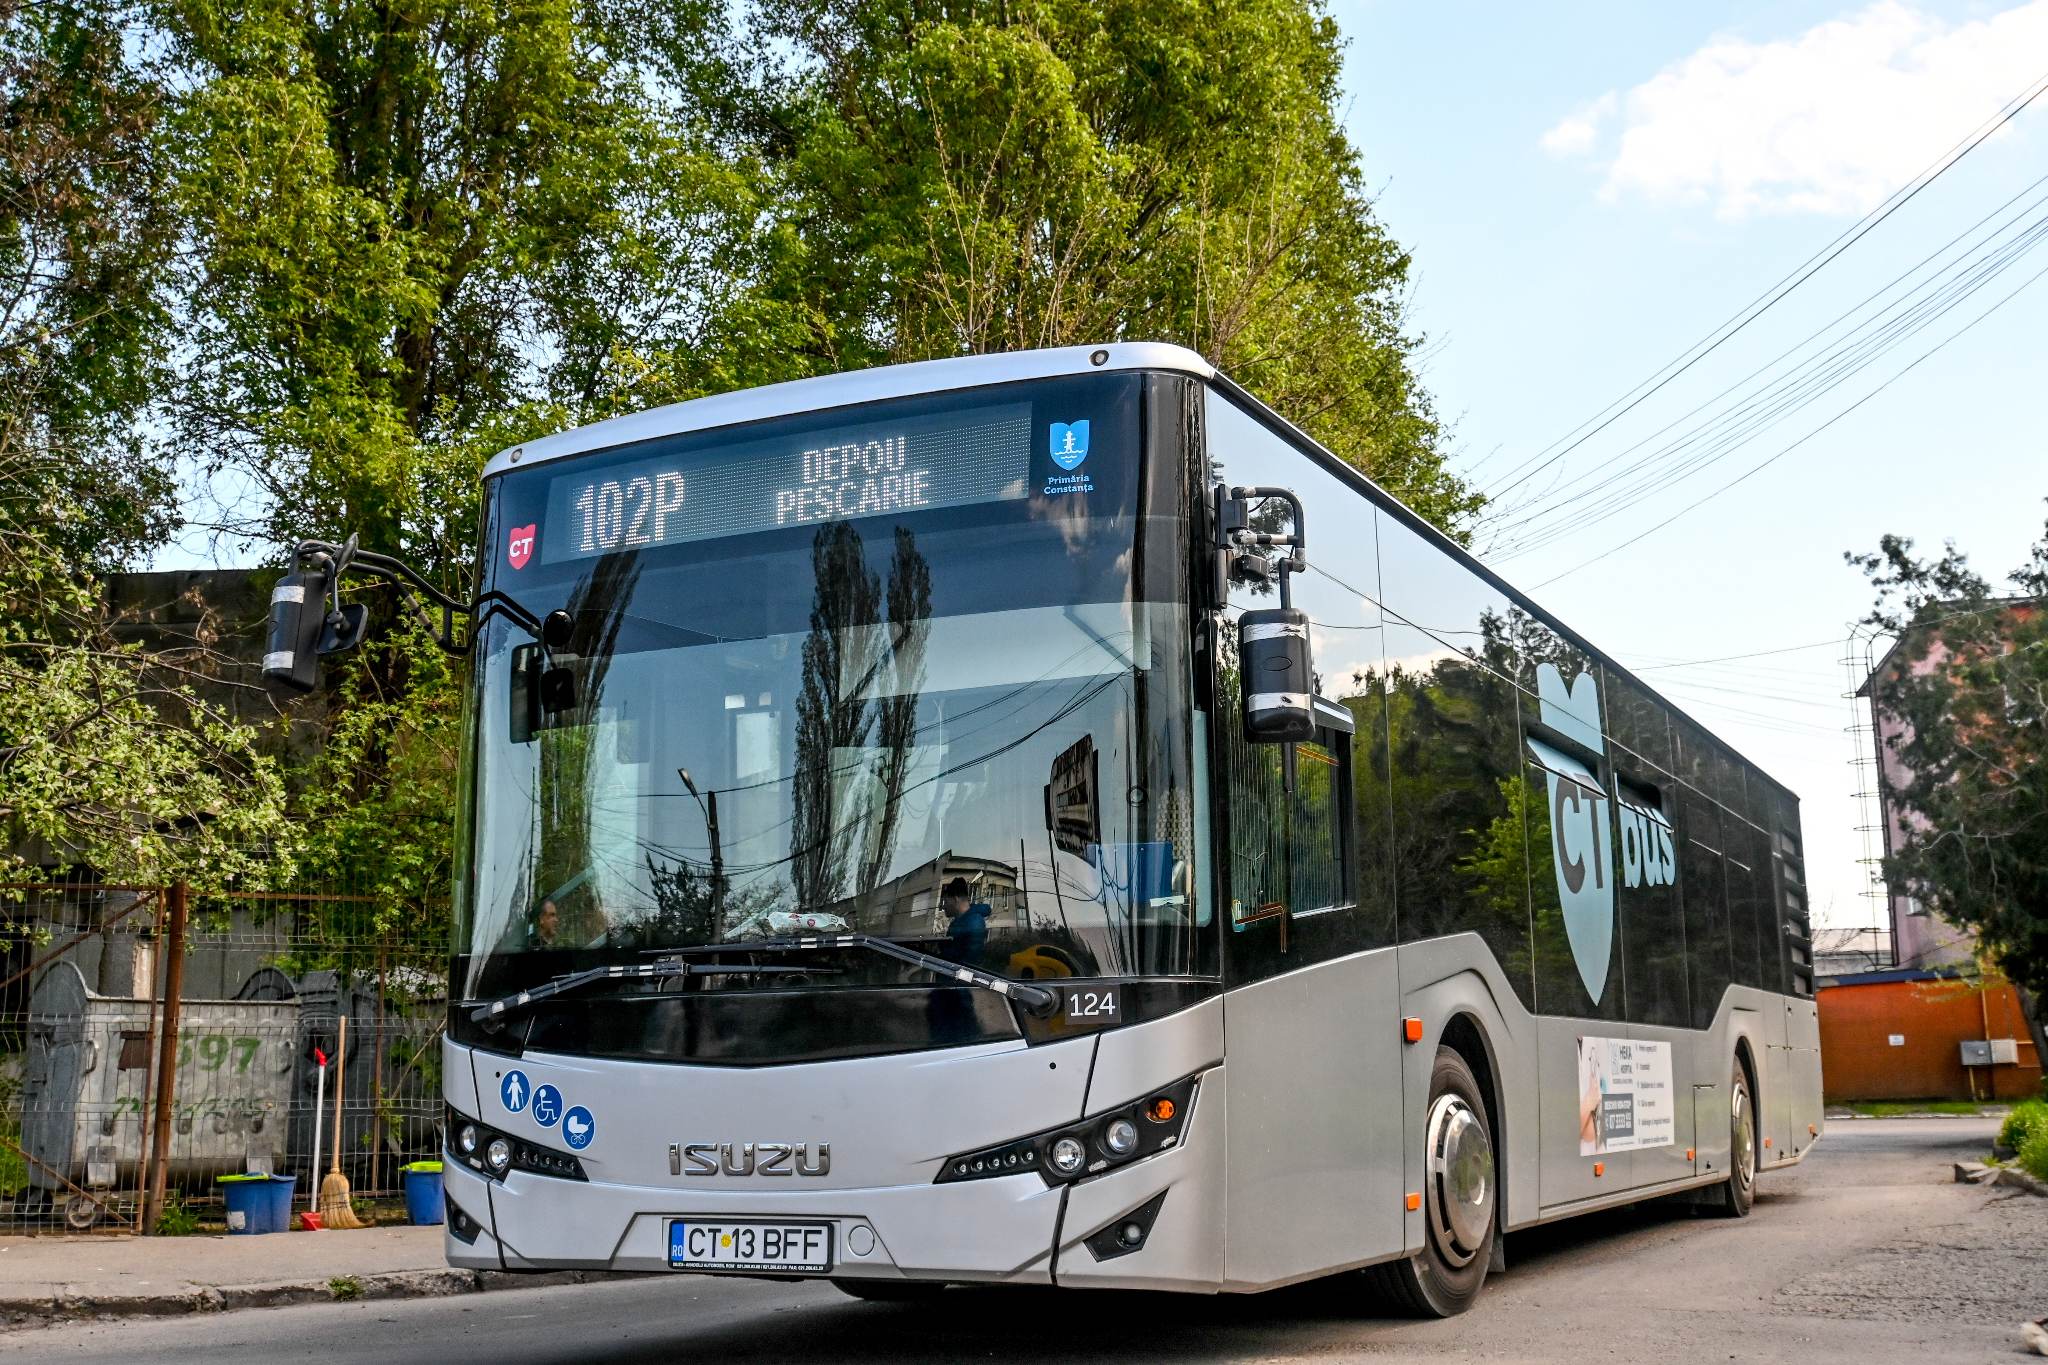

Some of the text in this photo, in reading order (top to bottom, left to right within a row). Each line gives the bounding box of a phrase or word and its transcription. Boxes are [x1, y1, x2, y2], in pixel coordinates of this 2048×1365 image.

[803, 436, 905, 484] DEPOU
[576, 471, 684, 551] 102P
[776, 470, 930, 525] PESCARIE
[510, 538, 532, 557] CT
[1614, 772, 1676, 889] bus
[1070, 992, 1116, 1017] 124
[668, 1142, 831, 1177] ISUZU
[672, 1245, 683, 1257] RO
[688, 1227, 823, 1260] CT 13 BFF
